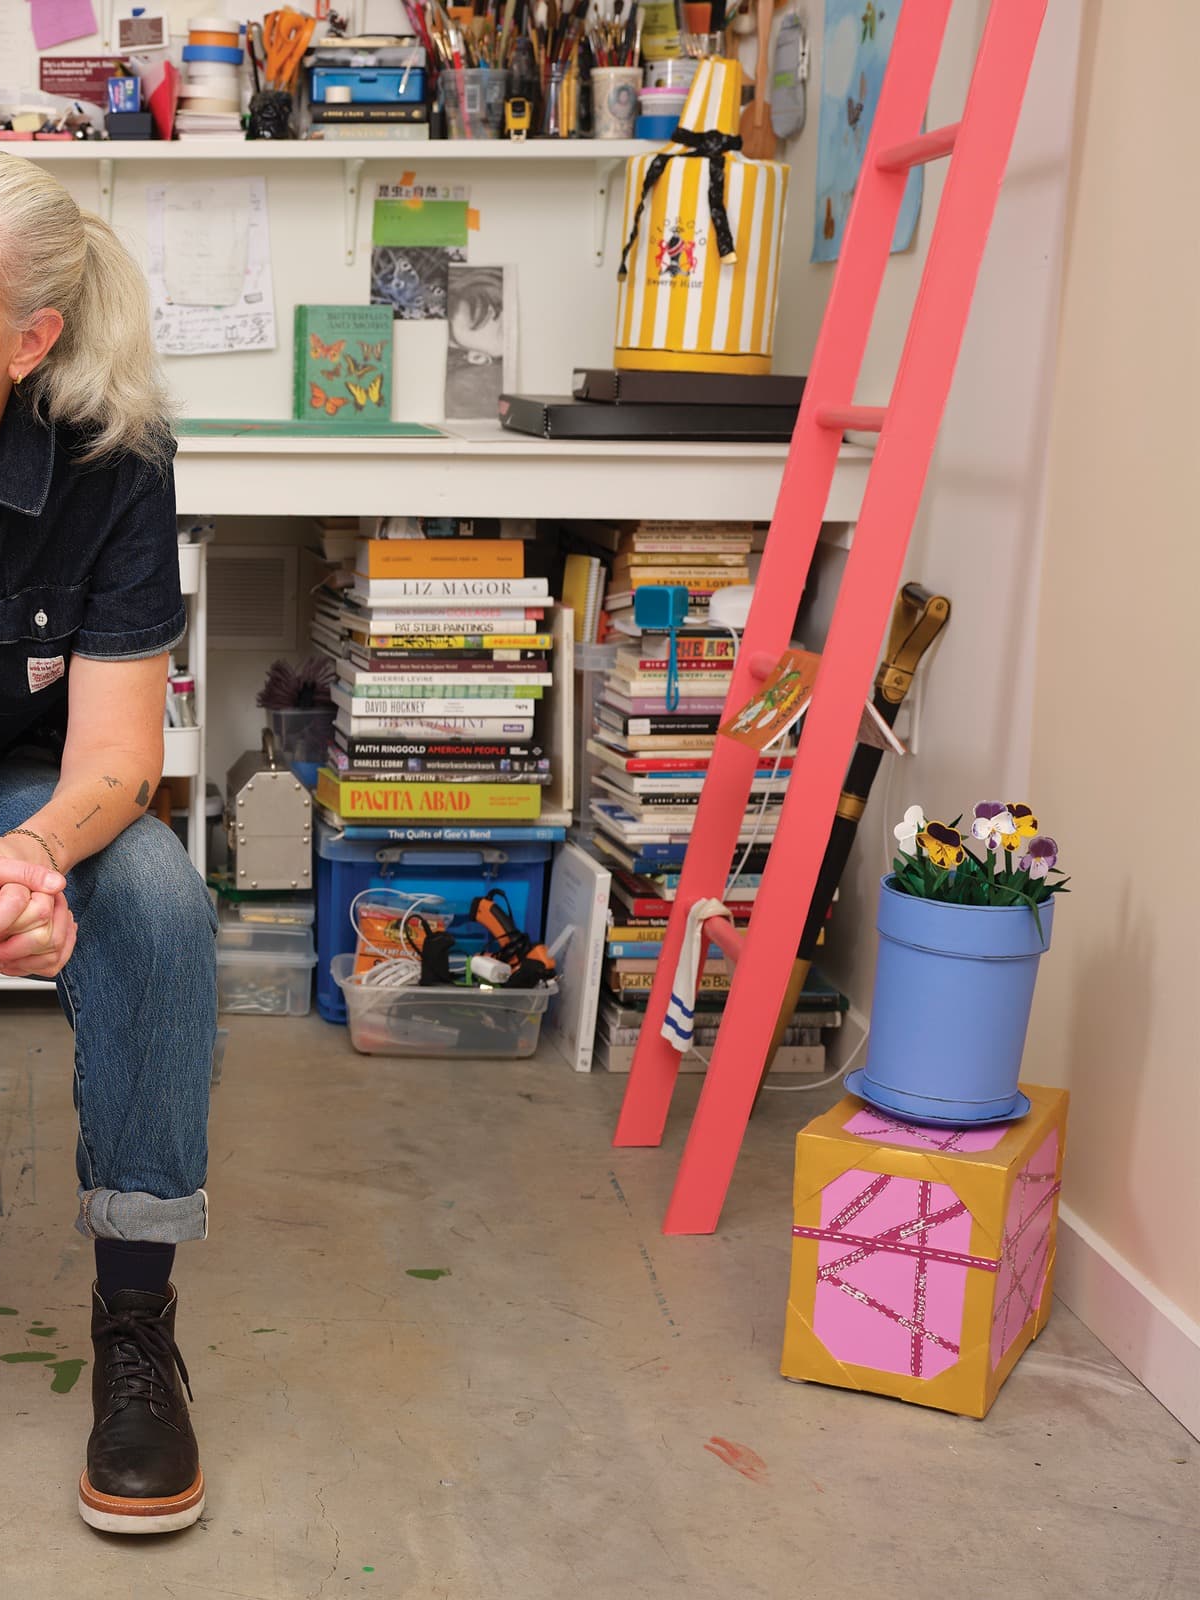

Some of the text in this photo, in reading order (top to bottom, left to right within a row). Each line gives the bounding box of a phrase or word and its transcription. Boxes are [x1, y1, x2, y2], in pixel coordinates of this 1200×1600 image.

[403, 582, 513, 596] LIZ MAGOR
[394, 623, 494, 633] PAT STEIR PAINTINGS
[365, 701, 425, 713] DAVID HOCKNEY
[355, 745, 380, 754] FAITH
[381, 745, 426, 754] RINGGOLD
[428, 746, 473, 755] AMERICAN
[474, 746, 506, 755] PEOPLE
[353, 760, 380, 769] CHARLES
[405, 774, 436, 782] WITHIN
[350, 790, 413, 812] PACITA
[419, 790, 471, 812] ABAD
[388, 830, 491, 839] The Quilts of Gee's Bend
[636, 932, 659, 941] ALICE
